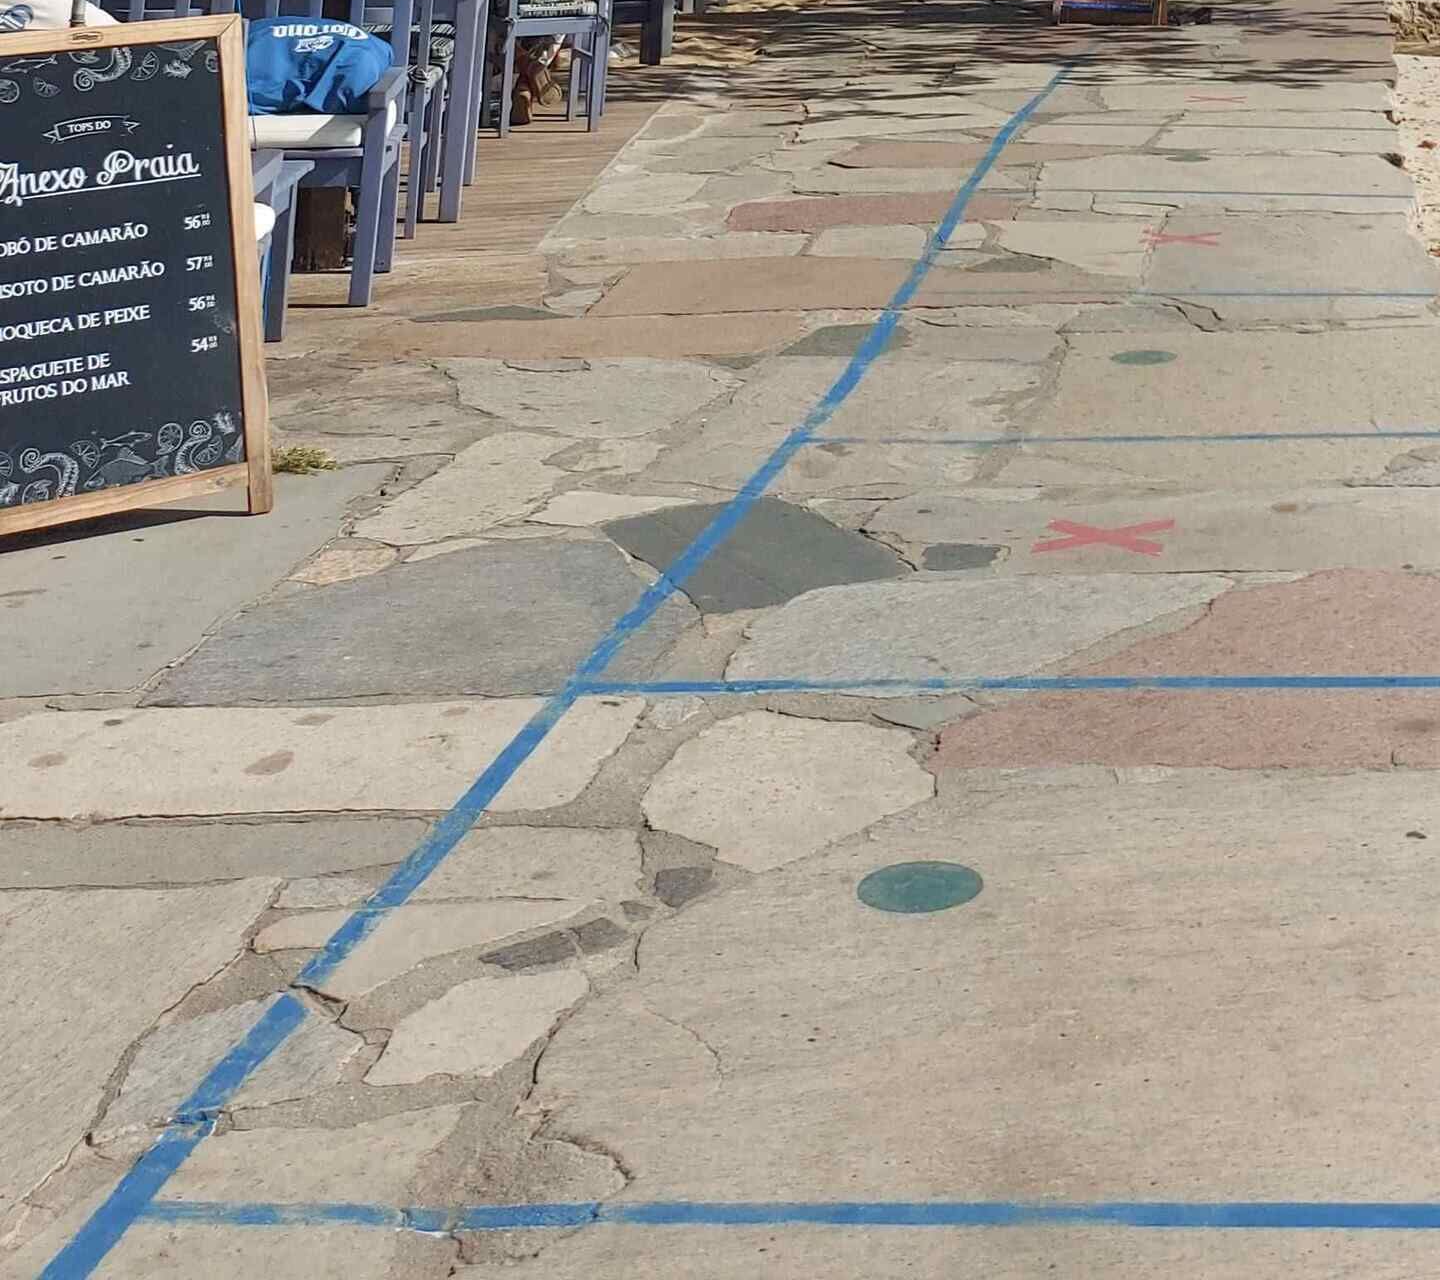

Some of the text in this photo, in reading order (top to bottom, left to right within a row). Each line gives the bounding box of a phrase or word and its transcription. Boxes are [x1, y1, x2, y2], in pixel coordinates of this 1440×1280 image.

[268, 24, 369, 40] Corona
[66, 120, 112, 134] TOPS DO
[0, 144, 200, 207] Anexo Praia
[34, 236, 58, 253] DE
[61, 222, 149, 248] CAMARÃO
[184, 214, 201, 230] 56
[52, 274, 76, 291] DE
[79, 260, 165, 287] CAMARÃO
[186, 256, 202, 271] 57
[0, 317, 75, 341] OQUECA
[78, 312, 101, 329] DE
[104, 305, 151, 326] PEIXE
[189, 296, 205, 311] 56
[87, 352, 111, 369] DE
[191, 337, 208, 352] 54
[0, 371, 131, 407] RUTOS DO MAR
